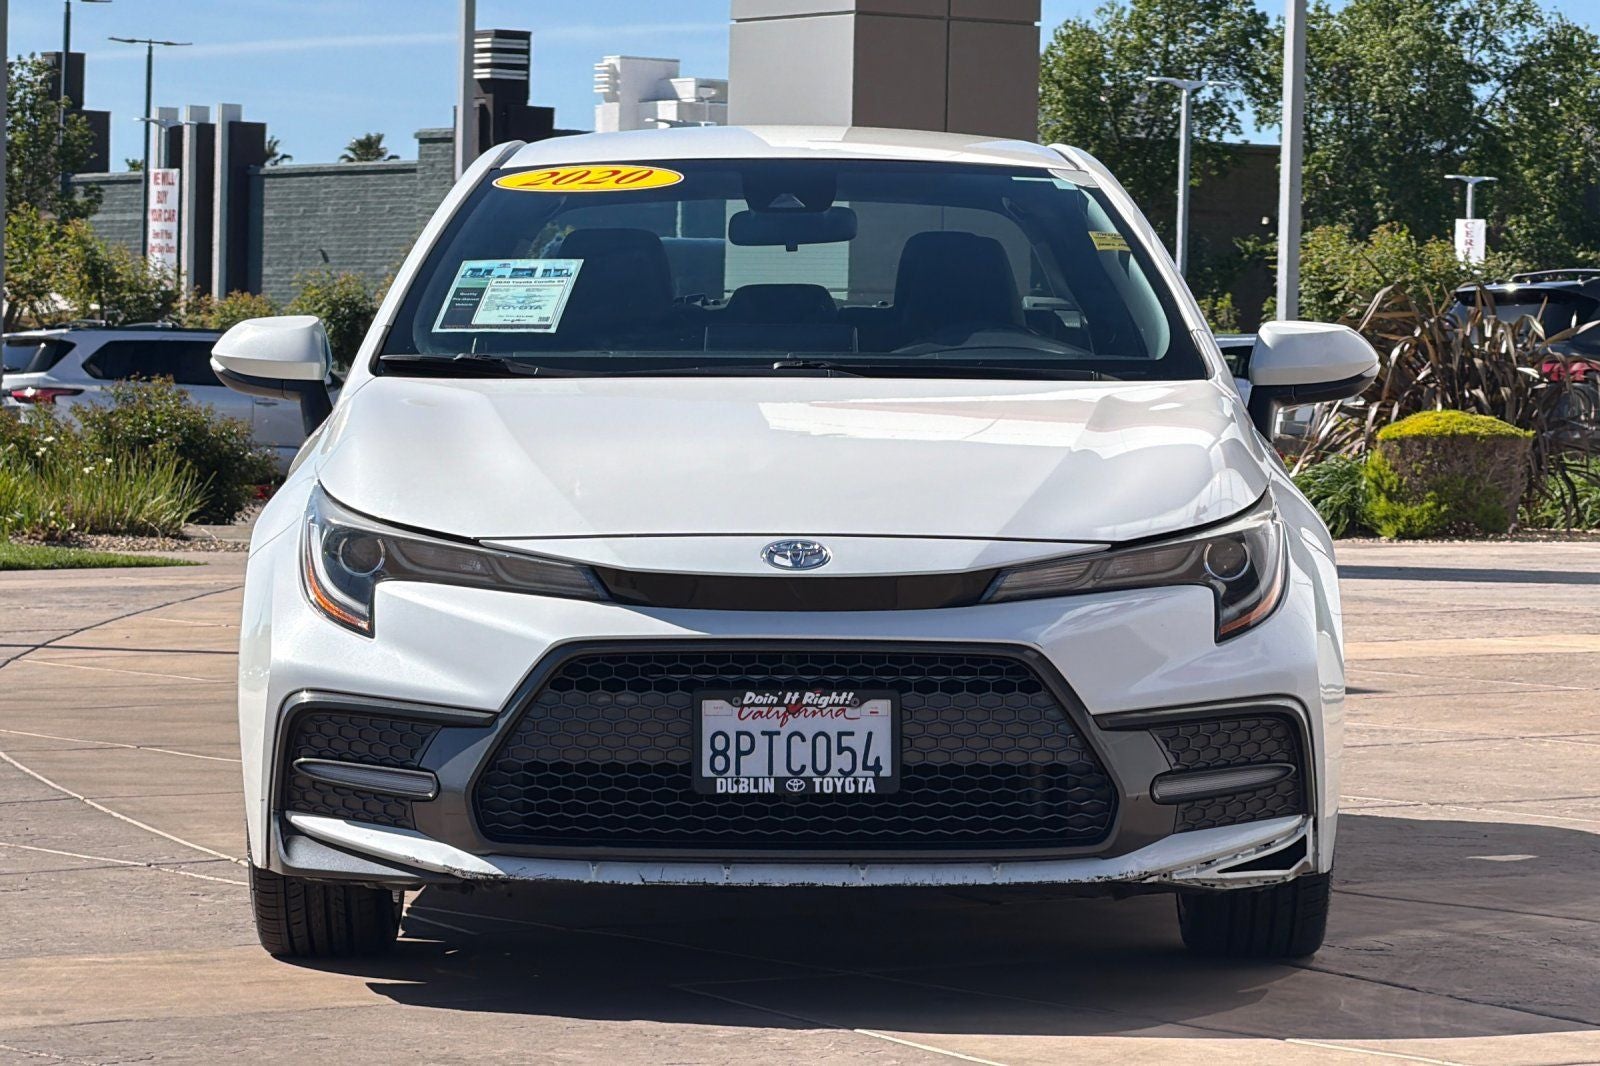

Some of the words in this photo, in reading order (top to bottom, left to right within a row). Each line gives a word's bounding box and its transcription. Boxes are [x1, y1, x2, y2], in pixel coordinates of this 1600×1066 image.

[517, 169, 654, 187] 2020
[742, 691, 782, 705] Doin'
[783, 691, 800, 705] It
[802, 691, 854, 709] Right!
[709, 730, 883, 776] 8PTC054
[716, 777, 775, 794] DUBLIN
[812, 777, 876, 794] TOYOTA
